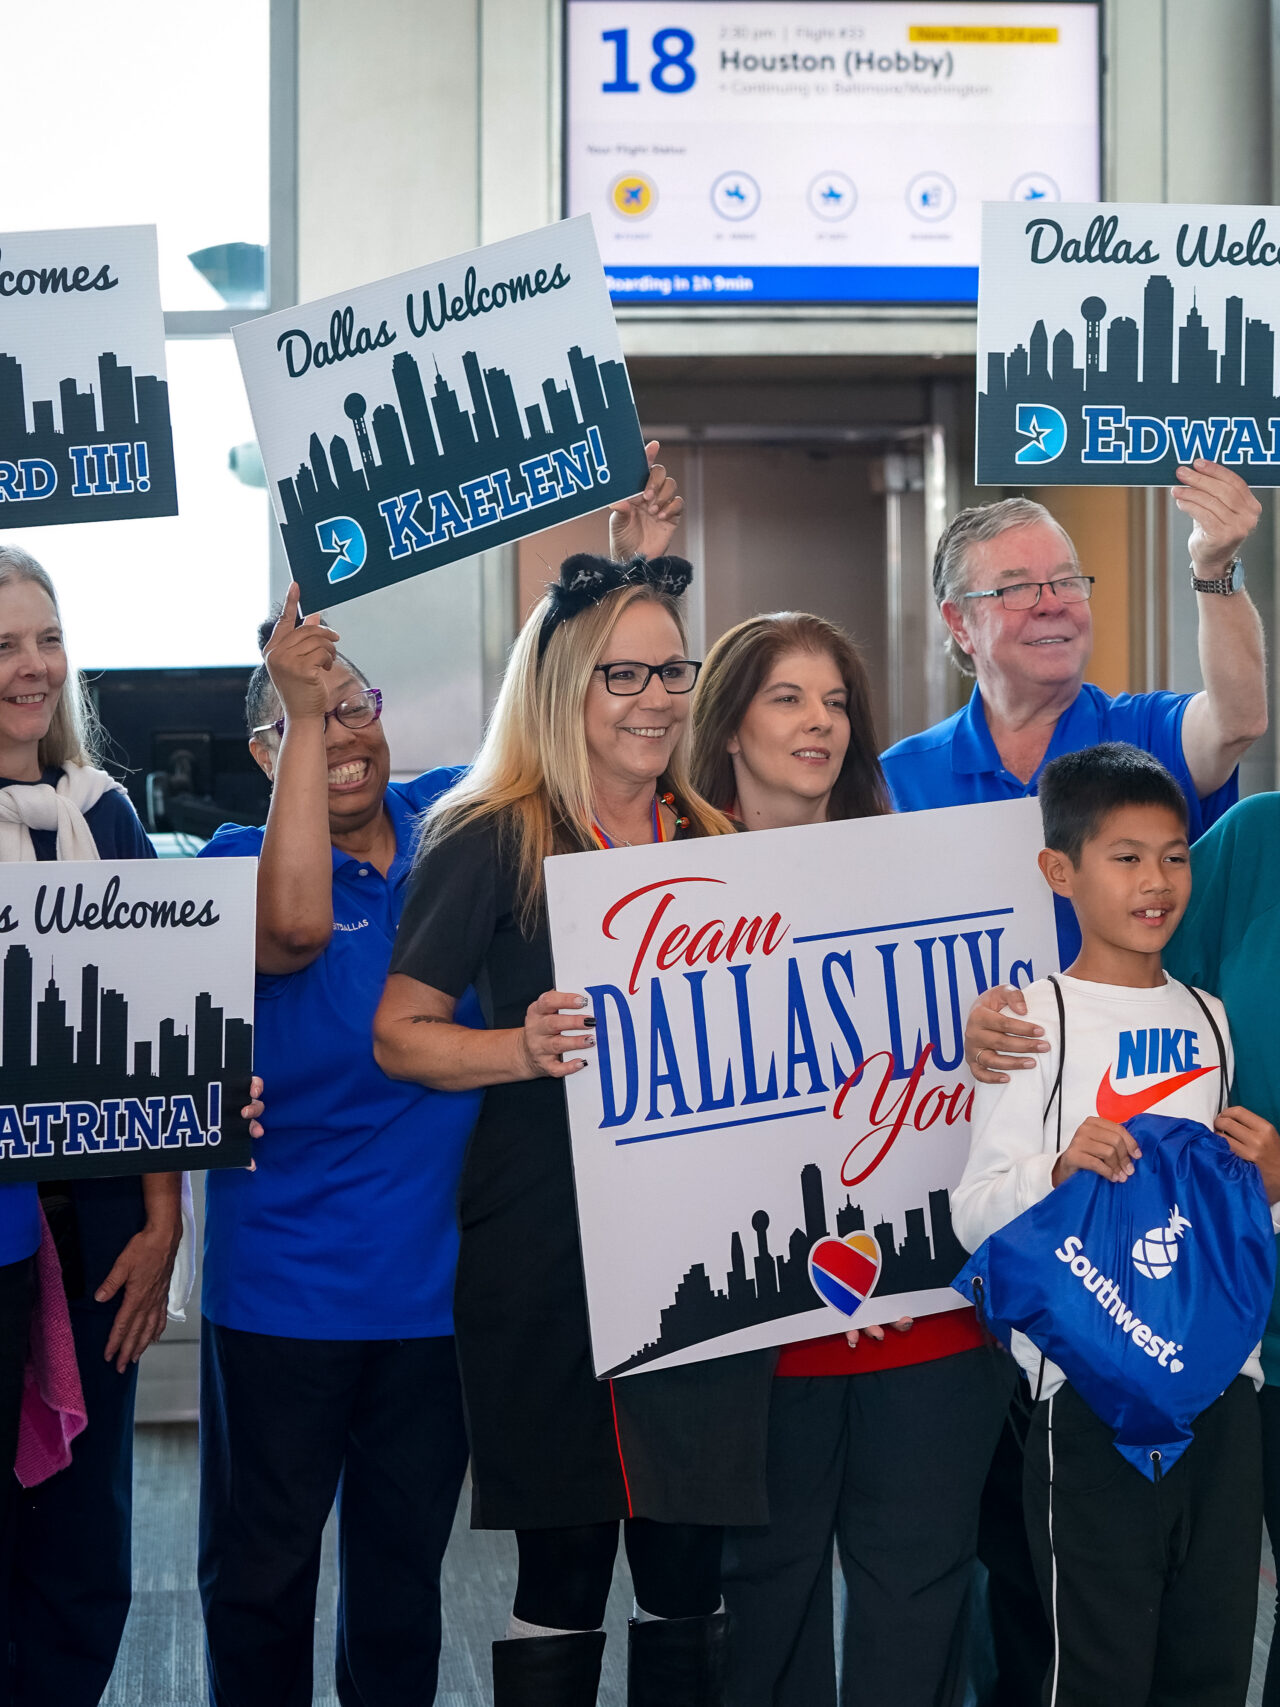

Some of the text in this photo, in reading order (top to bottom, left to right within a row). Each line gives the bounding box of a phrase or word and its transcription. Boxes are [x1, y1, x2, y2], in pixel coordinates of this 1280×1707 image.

[601, 27, 697, 94] 18
[719, 49, 954, 78] Houston (Hobby)
[1025, 215, 1160, 264] Dallas
[0, 260, 118, 296] comes
[605, 274, 672, 296] Boarding
[673, 274, 690, 291] in
[713, 274, 754, 292] 9min
[277, 265, 571, 378] Dallas Welcomes
[69, 441, 150, 497] III!
[378, 425, 611, 560] KAELEN!
[35, 875, 220, 935] Welcomes
[601, 877, 791, 995] Team
[584, 927, 1034, 1129] DALLAS LUV
[1116, 1027, 1201, 1080] NIKE
[0, 1081, 222, 1159] ATRINA!
[1054, 1235, 1180, 1369] Southwest
